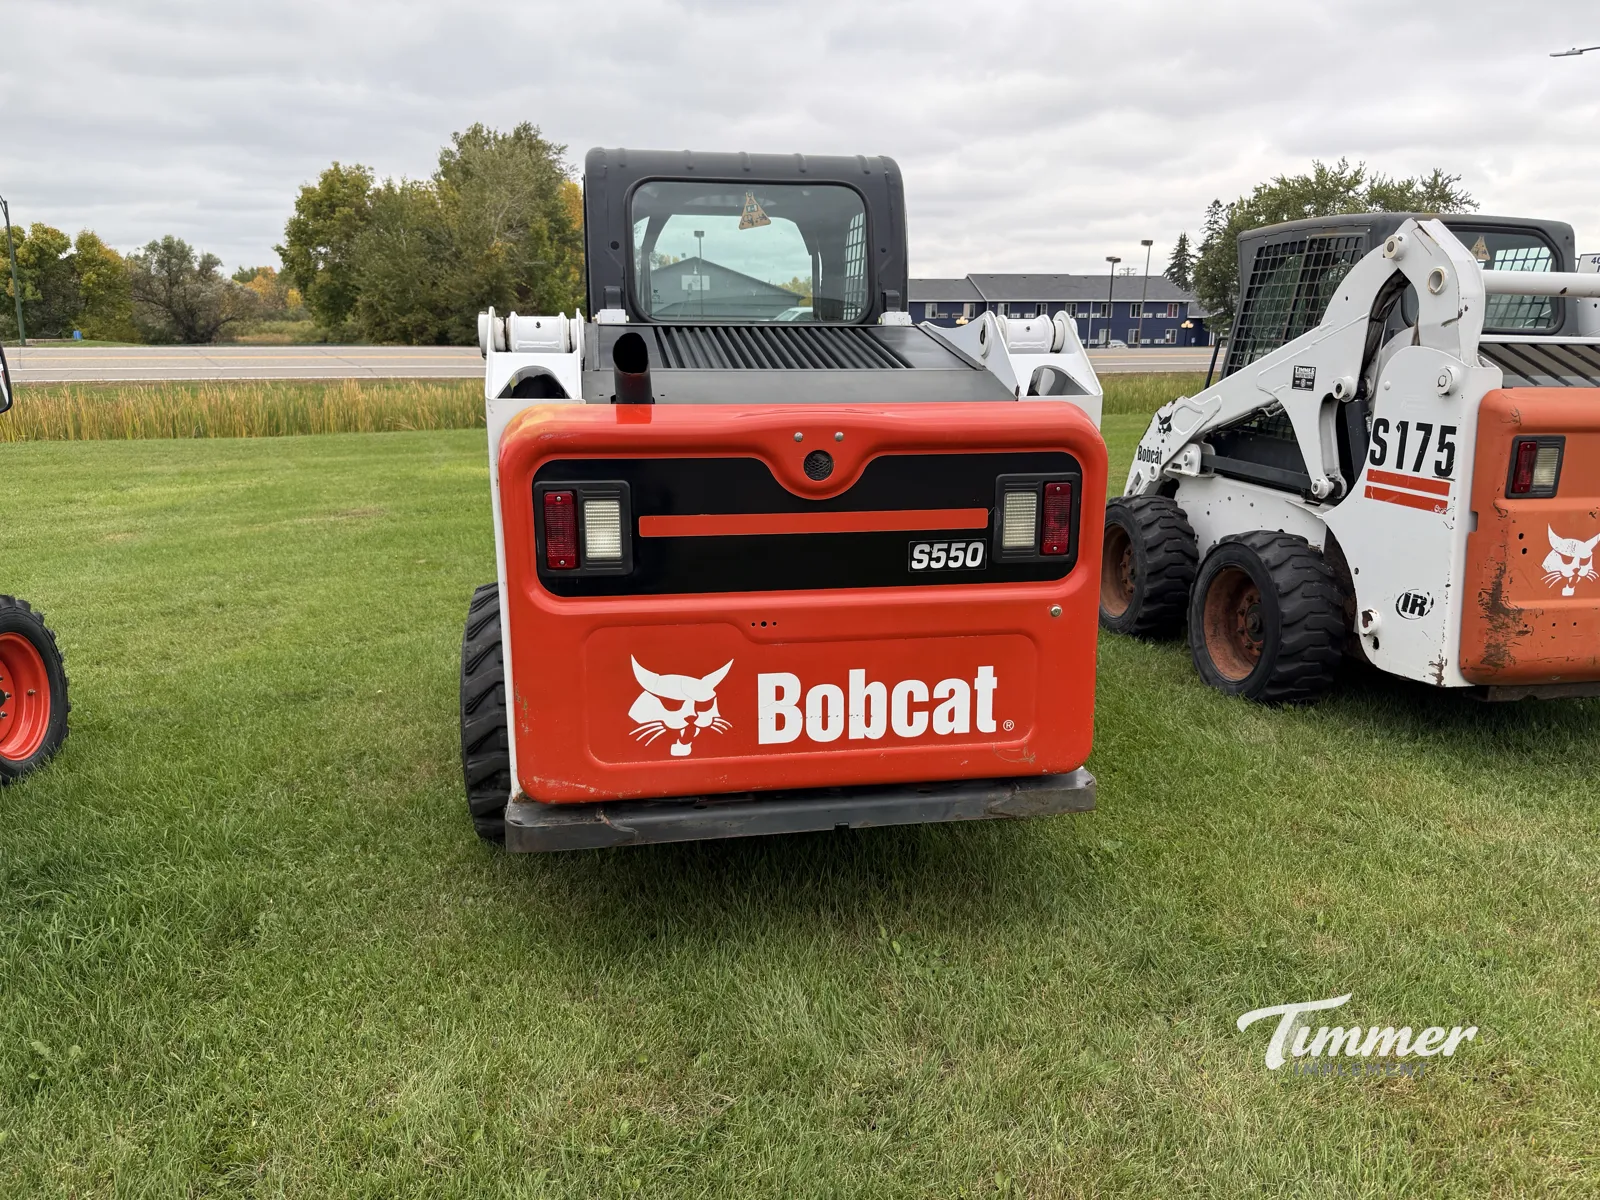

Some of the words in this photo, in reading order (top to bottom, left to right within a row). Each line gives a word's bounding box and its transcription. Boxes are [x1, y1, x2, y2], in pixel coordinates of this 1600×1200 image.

[1137, 445, 1163, 465] Bobcat
[1369, 418, 1457, 477] S175
[911, 542, 984, 570] S550
[758, 665, 997, 744] Bobcat
